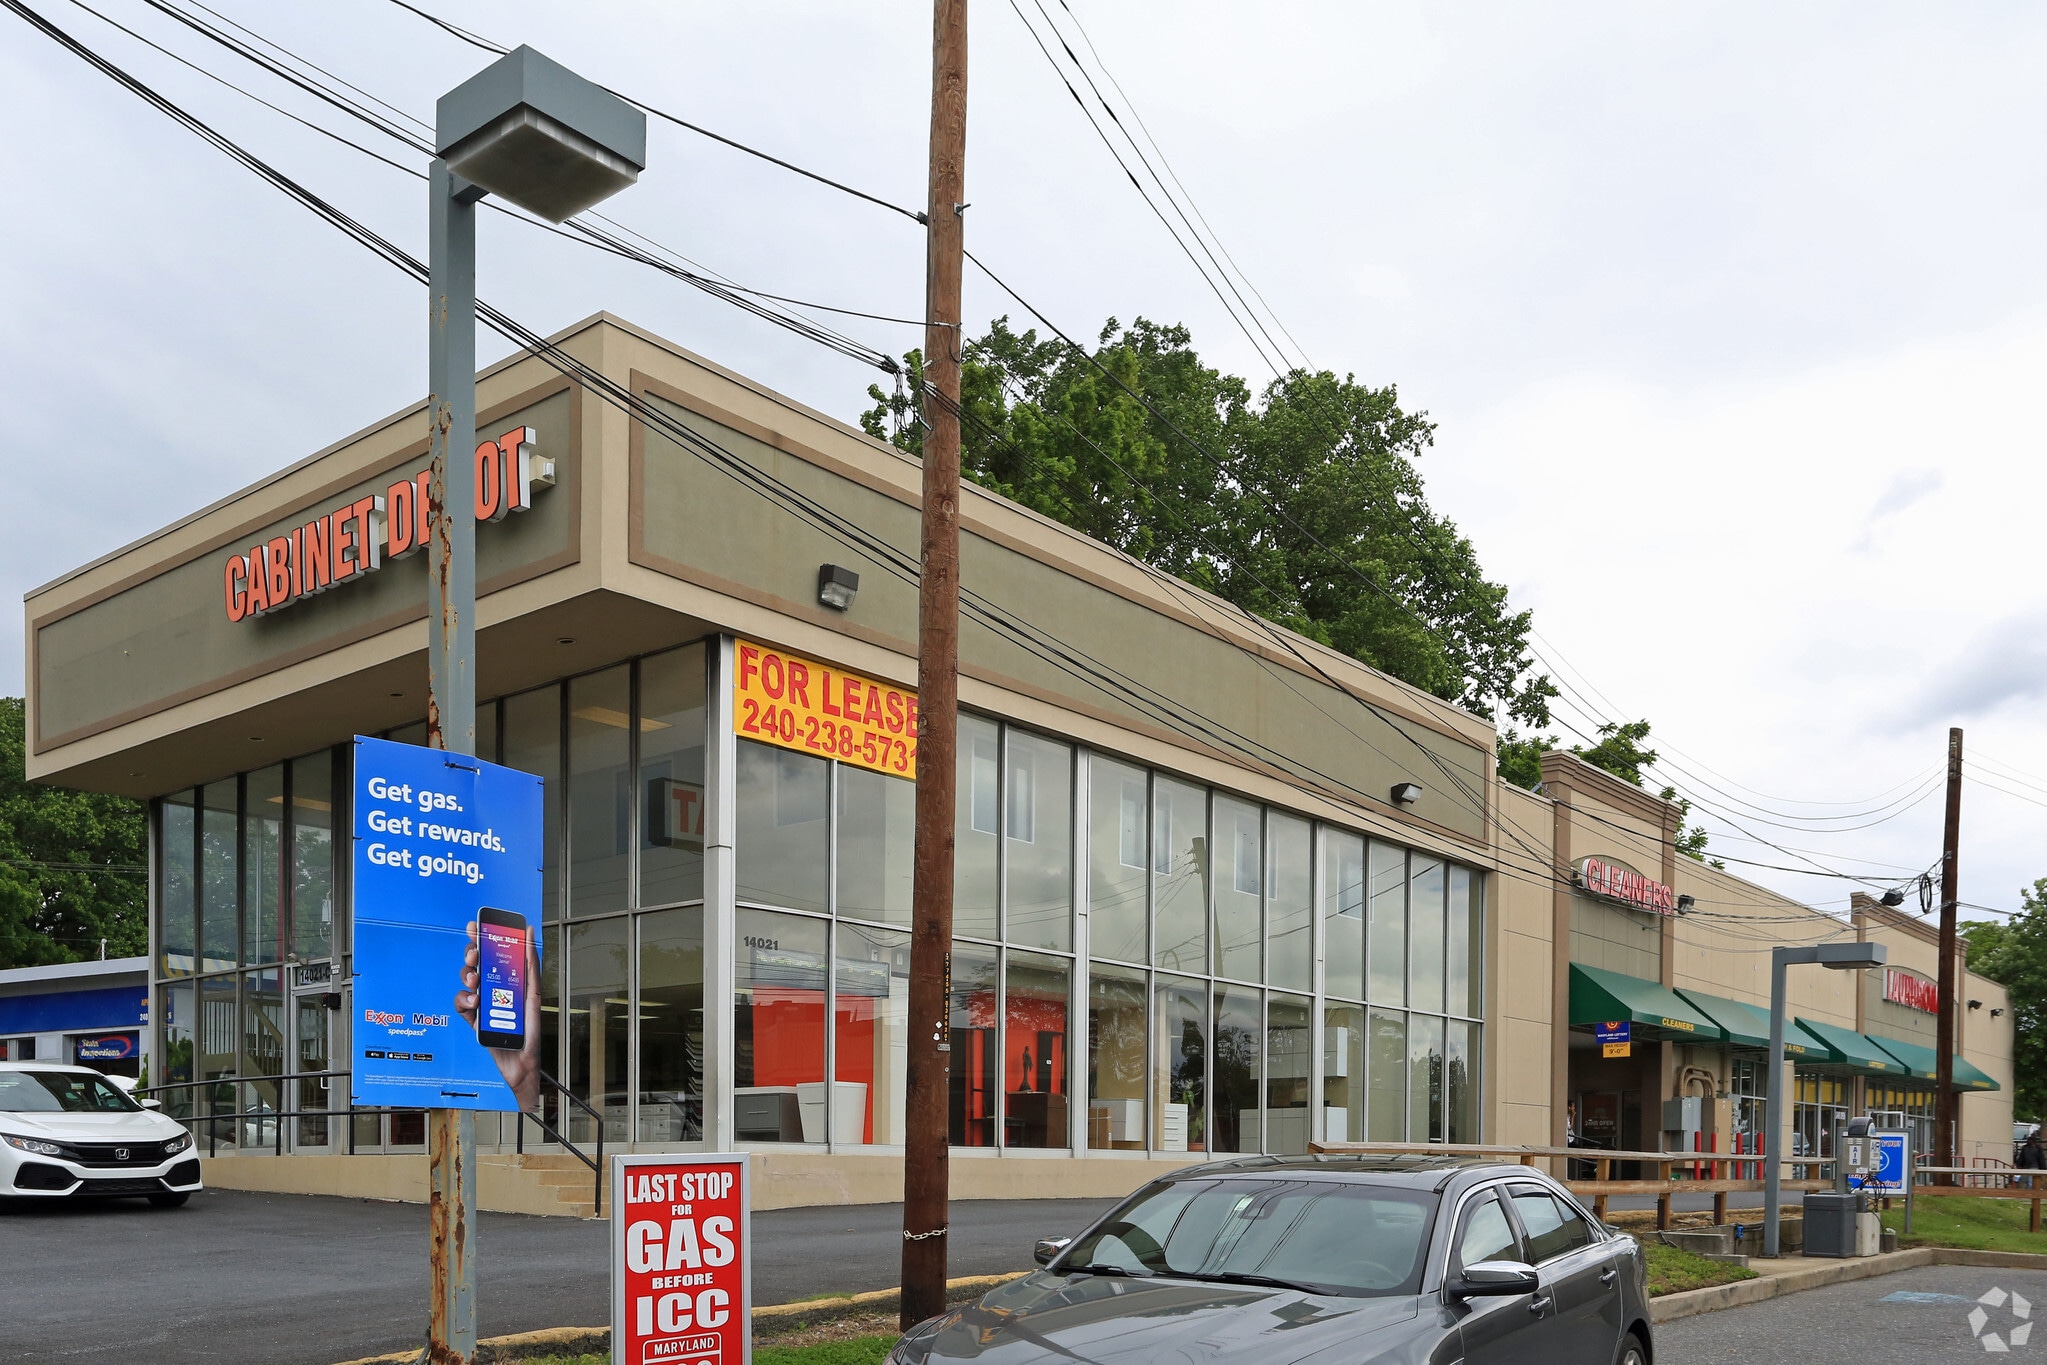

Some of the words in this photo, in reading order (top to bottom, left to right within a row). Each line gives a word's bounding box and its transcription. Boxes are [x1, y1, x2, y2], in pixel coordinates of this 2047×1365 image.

[224, 494, 383, 623] CABINET
[387, 425, 533, 558] DEOT
[739, 644, 811, 710] FOR
[822, 671, 919, 739] LEASE
[368, 777, 412, 804] Get
[418, 789, 464, 813] gas.
[367, 810, 412, 836] Get
[418, 822, 506, 853] rewards.
[367, 843, 412, 869] Get
[417, 852, 484, 884] going.
[1586, 858, 1674, 915] CLEANERS
[743, 935, 779, 951] 14021
[1885, 969, 1939, 1014] LAUNDROM
[365, 1009, 403, 1026] Exxon
[412, 1013, 449, 1027] Mobil
[1662, 1017, 1695, 1032] CLEANERS
[80, 1048, 121, 1058] Inspections
[626, 1174, 678, 1204] LAST
[682, 1172, 734, 1201] STOP
[671, 1204, 692, 1216] FOR
[626, 1215, 735, 1274] GAS
[652, 1272, 714, 1290] BEFORE
[636, 1288, 730, 1337] ICC
[654, 1337, 715, 1356] MARYLAND
